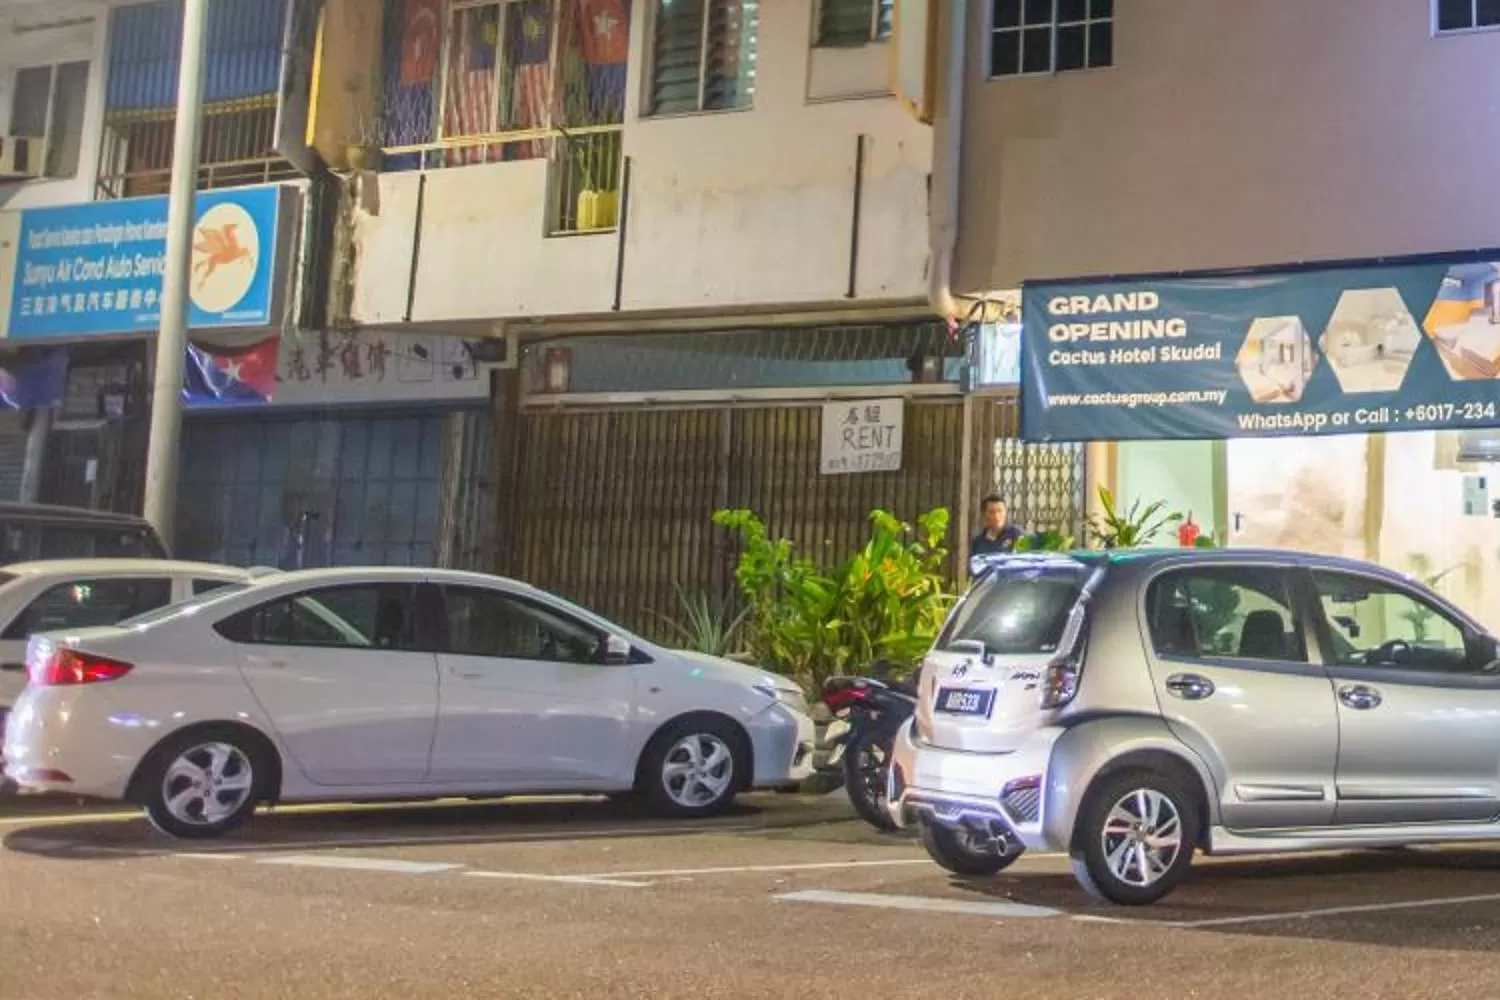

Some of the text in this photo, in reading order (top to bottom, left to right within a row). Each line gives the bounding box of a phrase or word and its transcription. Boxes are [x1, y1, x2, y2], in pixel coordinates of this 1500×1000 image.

[105, 254, 132, 280] Auto
[1048, 291, 1159, 316] GRAND
[1048, 318, 1188, 343] OPENING
[1048, 342, 1222, 366] Cactus Hotel Skudai
[1047, 389, 1228, 410] www.cactusgroup.com.my
[1238, 411, 1327, 431] WhatsApp
[1331, 412, 1351, 426] or
[1354, 407, 1390, 425] Call
[1404, 403, 1496, 422] +6017-234
[842, 425, 897, 451] RENT
